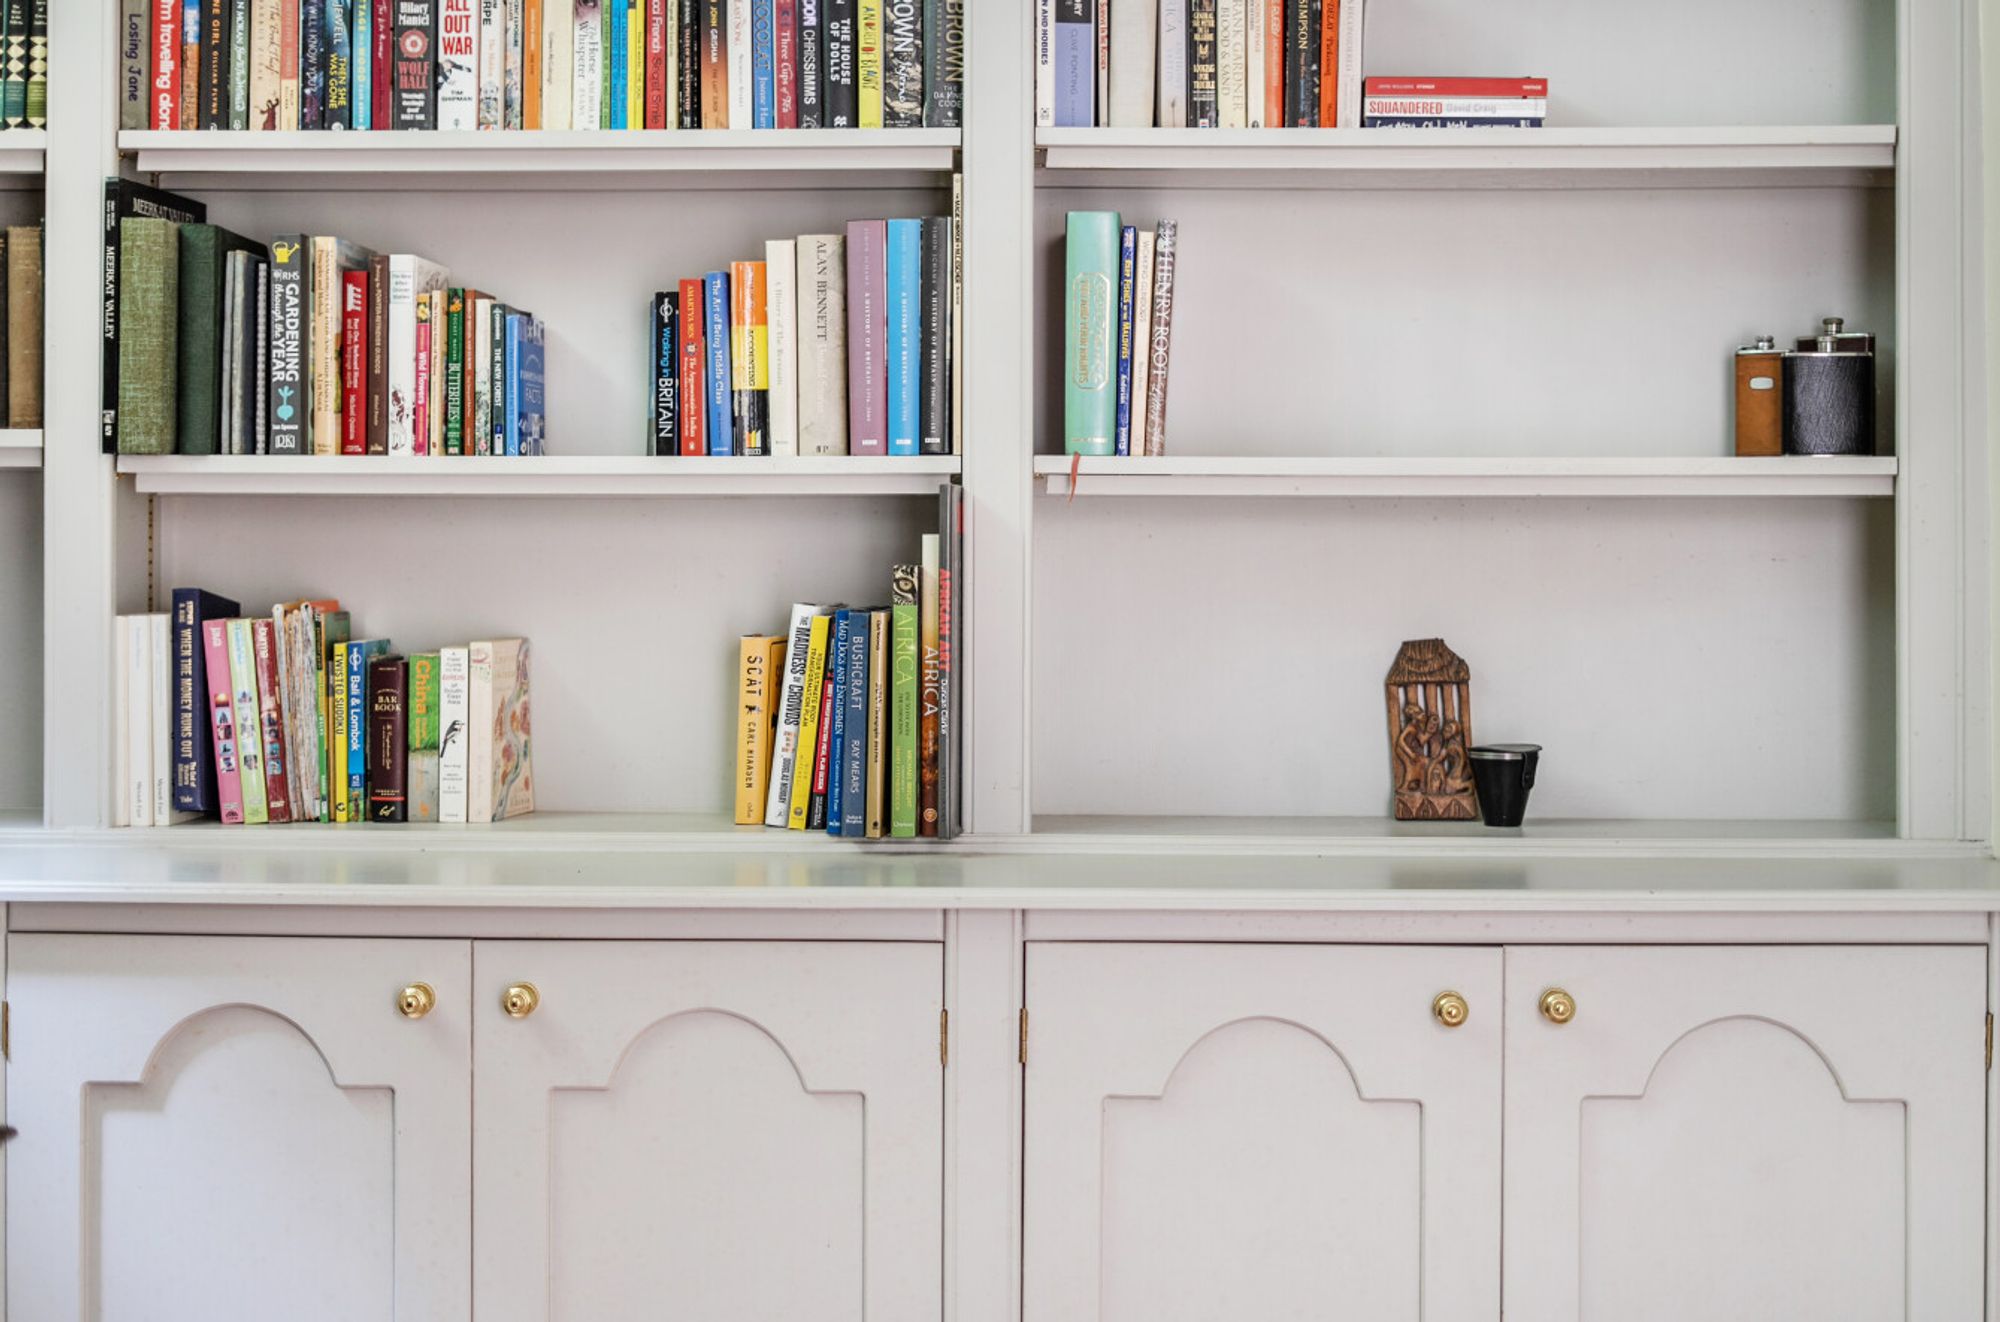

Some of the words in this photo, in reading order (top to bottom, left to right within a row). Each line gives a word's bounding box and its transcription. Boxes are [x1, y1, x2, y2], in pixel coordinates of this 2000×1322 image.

[308, 5, 318, 27] WILL
[445, 0, 470, 12] ALL
[709, 6, 719, 27] JOHN
[1040, 8, 1049, 28] AND
[126, 13, 142, 60] Losing
[212, 19, 221, 45] GIRL
[235, 11, 245, 44] MORAN
[332, 4, 345, 45] JEWELL
[444, 14, 472, 34] OUT
[651, 16, 663, 54] French
[830, 22, 840, 38] OF
[840, 18, 851, 42] THE
[1220, 7, 1232, 49] BLOOD
[1298, 0, 1309, 50] SIMPSON
[306, 34, 318, 65] KNOW
[442, 36, 474, 56] WAR
[576, 20, 589, 80] Whisperer
[588, 41, 599, 75] Horse
[709, 28, 719, 64] GRISHAM
[780, 31, 791, 60] Three
[1040, 28, 1049, 66] HOBBES
[1220, 50, 1231, 61] &
[328, 53, 338, 76] WAS
[338, 56, 347, 86] THEN
[398, 61, 430, 76] WOLF
[652, 57, 662, 91] Secret
[778, 62, 794, 85] Cups
[830, 42, 840, 82] DOLLS
[840, 45, 851, 86] HOUSE
[129, 65, 142, 102] Jane
[1220, 63, 1232, 97] SAND
[1232, 42, 1244, 113] GARDNER
[211, 88, 219, 116] FLYNN
[328, 78, 338, 110] GONE
[338, 87, 347, 107] SHE
[651, 94, 663, 124] Smile
[781, 95, 792, 113] Tea
[1369, 101, 1443, 115] SQUANDERED
[1446, 102, 1471, 113] David
[1473, 102, 1497, 114] Craig
[132, 196, 168, 219] MEERKAT
[104, 245, 115, 297] MEERKAT
[816, 240, 828, 276] ALAN
[711, 279, 723, 295] The
[1154, 255, 1174, 321] HENRY
[271, 283, 285, 322] through
[712, 297, 723, 312] Art
[816, 280, 828, 341] BENNETT
[104, 299, 115, 340] VALLEY
[272, 322, 284, 338] the
[286, 282, 300, 383] GARDENING
[713, 313, 723, 323] of
[660, 327, 672, 367] Walking
[712, 324, 724, 348] Being
[865, 336, 871, 348] OF
[901, 336, 908, 348] OF
[931, 335, 938, 347] OF
[272, 336, 286, 383] YEAR
[417, 351, 427, 371] Wild
[494, 348, 503, 361] THE
[688, 356, 697, 369] The
[714, 350, 725, 380] Middle
[747, 329, 756, 387] ACCOUNTING
[1151, 326, 1170, 378] ROOT
[494, 362, 503, 380] NEW
[661, 368, 672, 378] in
[417, 372, 427, 405] Flowers
[448, 362, 461, 420] BUTTERFLIES
[494, 381, 503, 407] FOREST
[715, 381, 726, 405] Class
[658, 377, 674, 438] BRITAIN
[938, 568, 952, 635] AFRICAN
[799, 616, 809, 627] THE
[837, 619, 850, 640] MAD
[180, 628, 193, 657] WHEN
[209, 627, 223, 649] java
[258, 626, 269, 659] burma
[789, 626, 811, 675] MADNESS
[836, 641, 850, 665] DOGS
[895, 611, 915, 686] AFRICA
[180, 658, 193, 676] THE
[939, 639, 952, 672] ART
[335, 653, 345, 696] TWISTED
[350, 674, 361, 695] Bali
[415, 659, 432, 715] China
[745, 655, 762, 697] SCAT
[804, 648, 817, 706] TRANSFORMATION
[836, 666, 846, 683] AND
[850, 635, 865, 711] BUSHCRAFT
[923, 645, 940, 718] AFRICA
[180, 678, 193, 710] MONEY
[350, 696, 361, 706] &
[374, 704, 401, 712] BOOK
[377, 695, 398, 704] BAR
[784, 683, 805, 726] CROWDS
[940, 678, 949, 708] Duncan
[335, 697, 345, 736] SUDOKU
[801, 708, 810, 728] PLAN
[833, 684, 847, 735] ENGLISHMEN
[180, 712, 193, 738] RUNS
[350, 708, 362, 752] Lombok
[747, 721, 757, 745] CARL
[181, 740, 193, 759] OUT
[851, 739, 862, 758] RAY
[781, 757, 792, 782] DOUGLAS
[849, 759, 861, 793] MEARS
